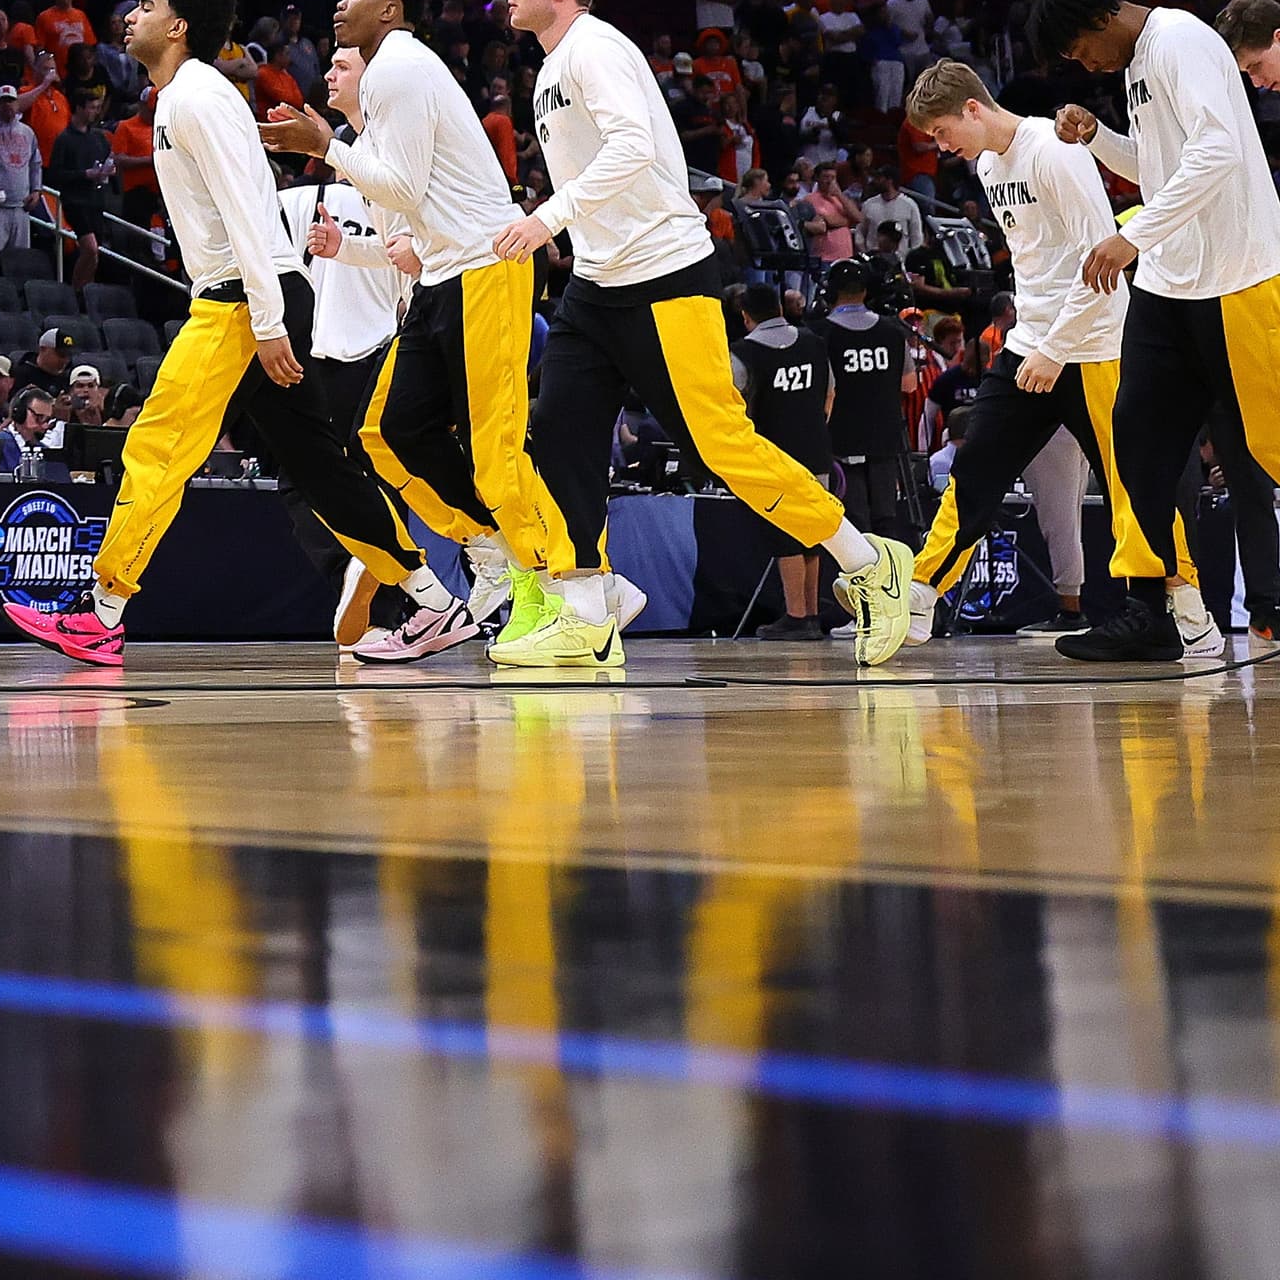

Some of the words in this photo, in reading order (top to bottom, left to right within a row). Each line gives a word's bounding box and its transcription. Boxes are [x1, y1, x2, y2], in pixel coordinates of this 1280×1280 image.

[987, 184, 1008, 208] OCK
[844, 347, 888, 372] 360
[774, 363, 812, 391] 427
[22, 501, 45, 515] SWEET
[4, 527, 72, 552] MARCH
